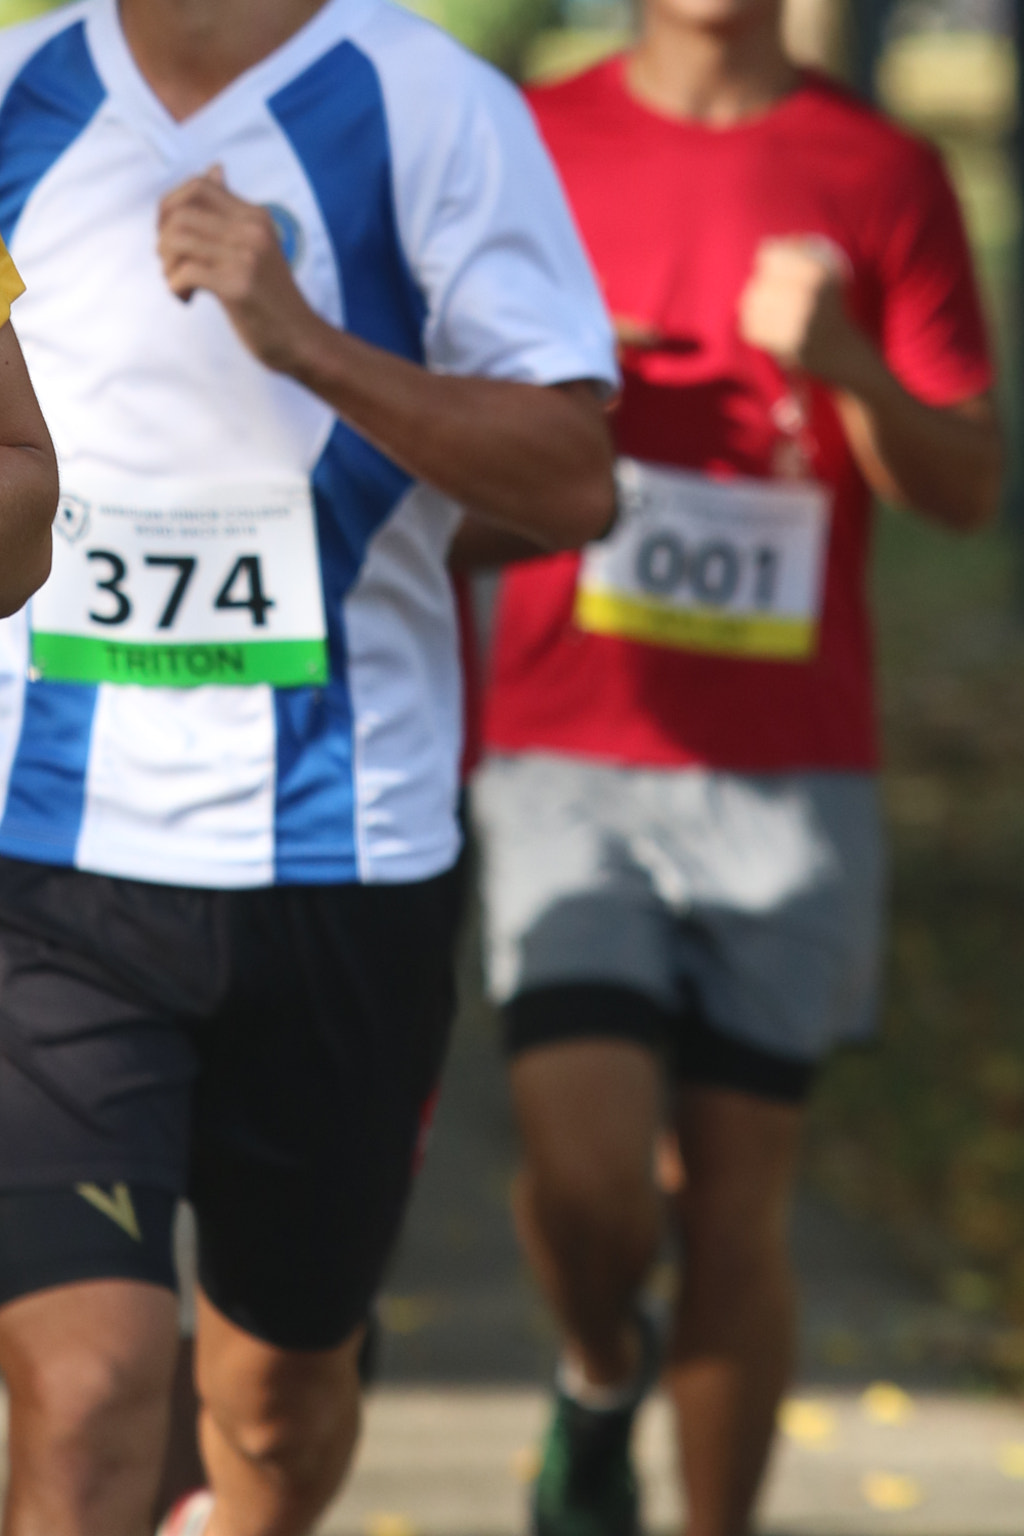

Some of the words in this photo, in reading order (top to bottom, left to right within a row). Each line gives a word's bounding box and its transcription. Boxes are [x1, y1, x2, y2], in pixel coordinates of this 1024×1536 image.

[87, 550, 276, 629] 374
[636, 530, 783, 610] 001
[106, 644, 245, 678] TRITON
